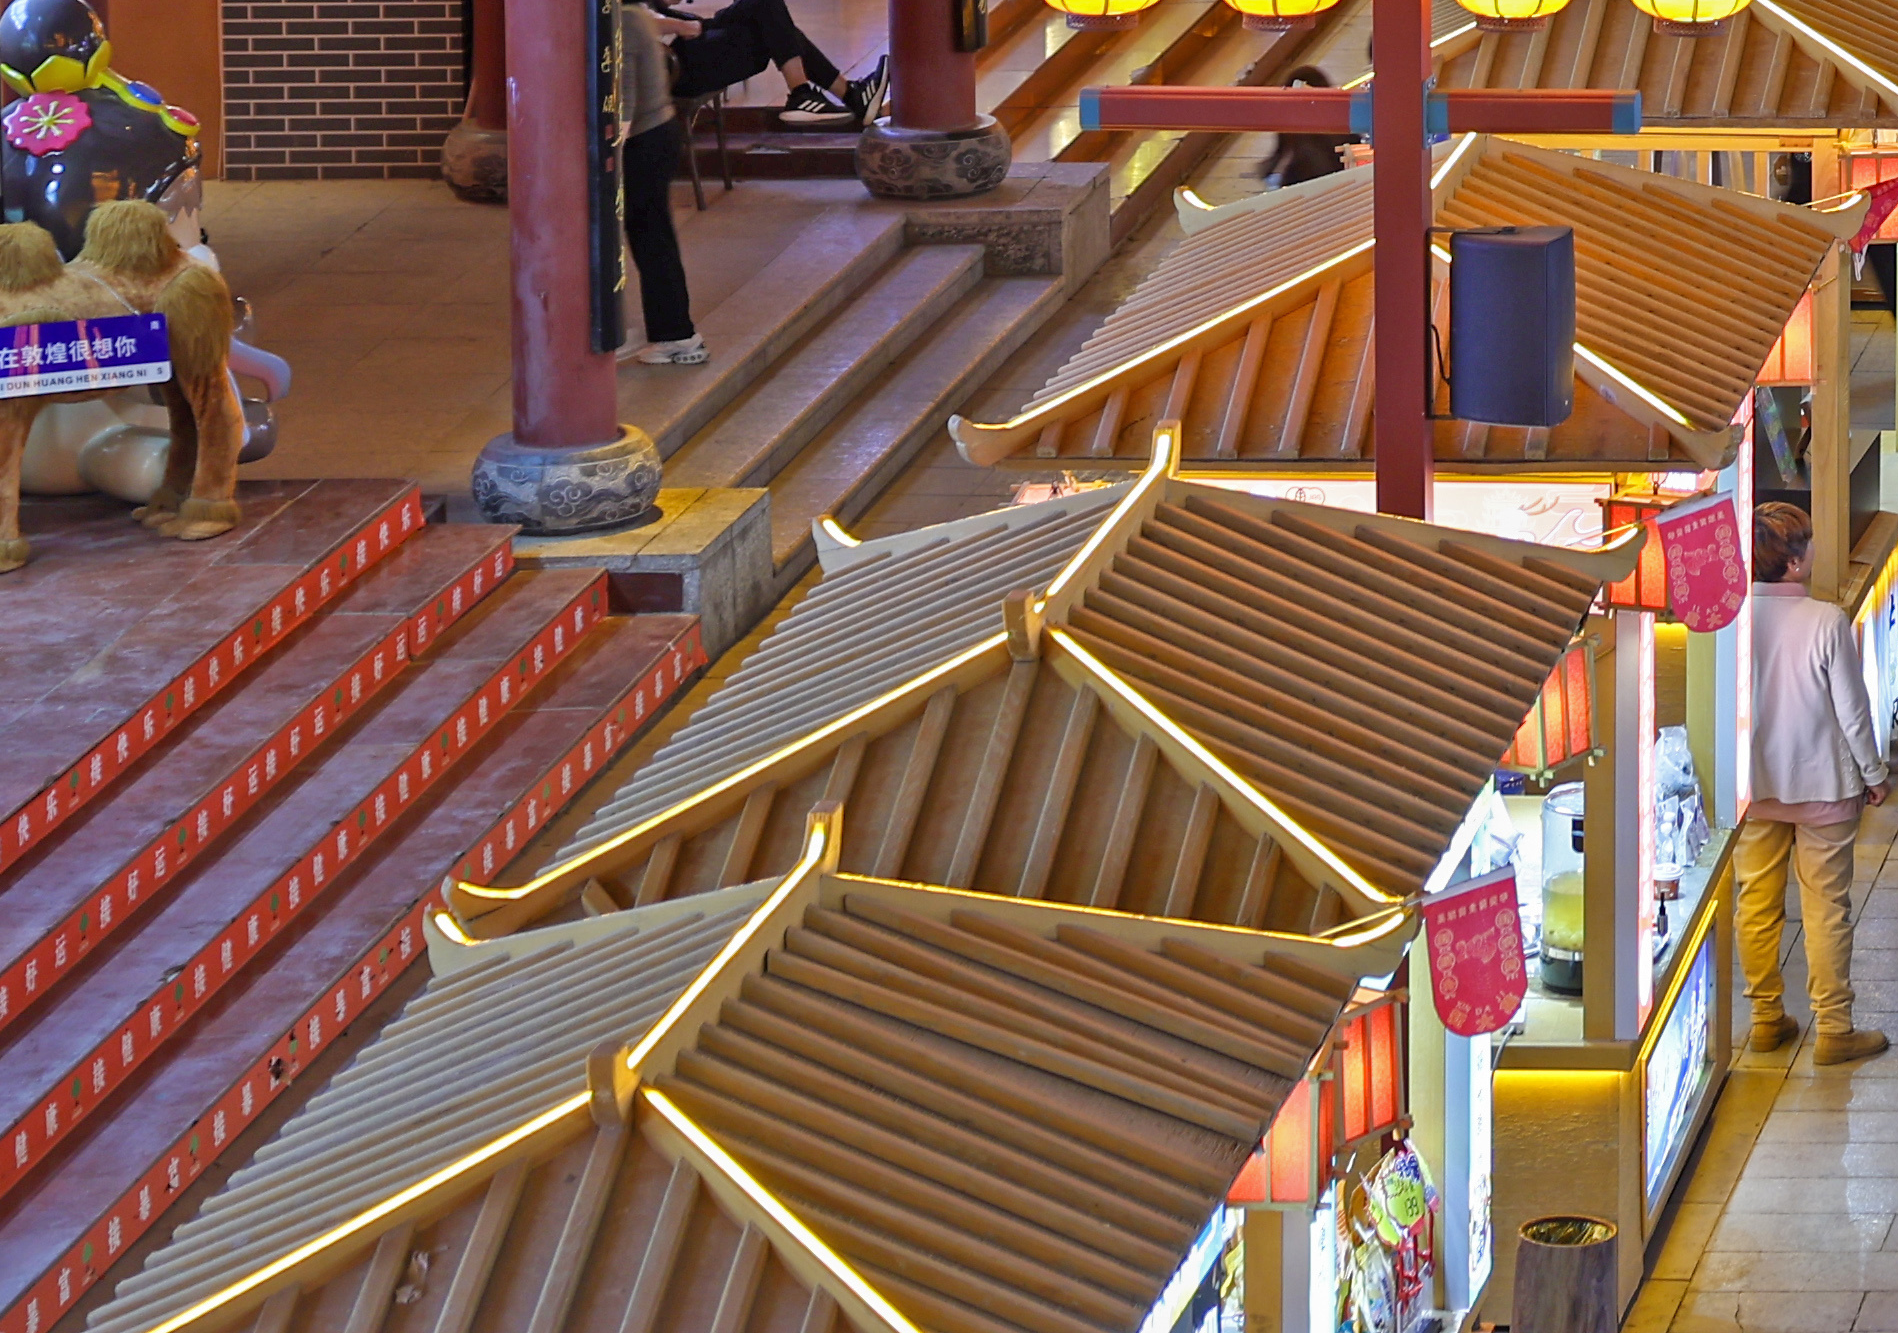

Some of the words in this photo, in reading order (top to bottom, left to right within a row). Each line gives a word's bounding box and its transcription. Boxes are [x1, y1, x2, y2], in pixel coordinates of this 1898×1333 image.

[0, 335, 138, 370] 在敦煌很想你
[6, 381, 31, 391] DUN
[33, 375, 74, 388] HUANG
[76, 373, 99, 383] HEN
[101, 370, 135, 381] XIANG
